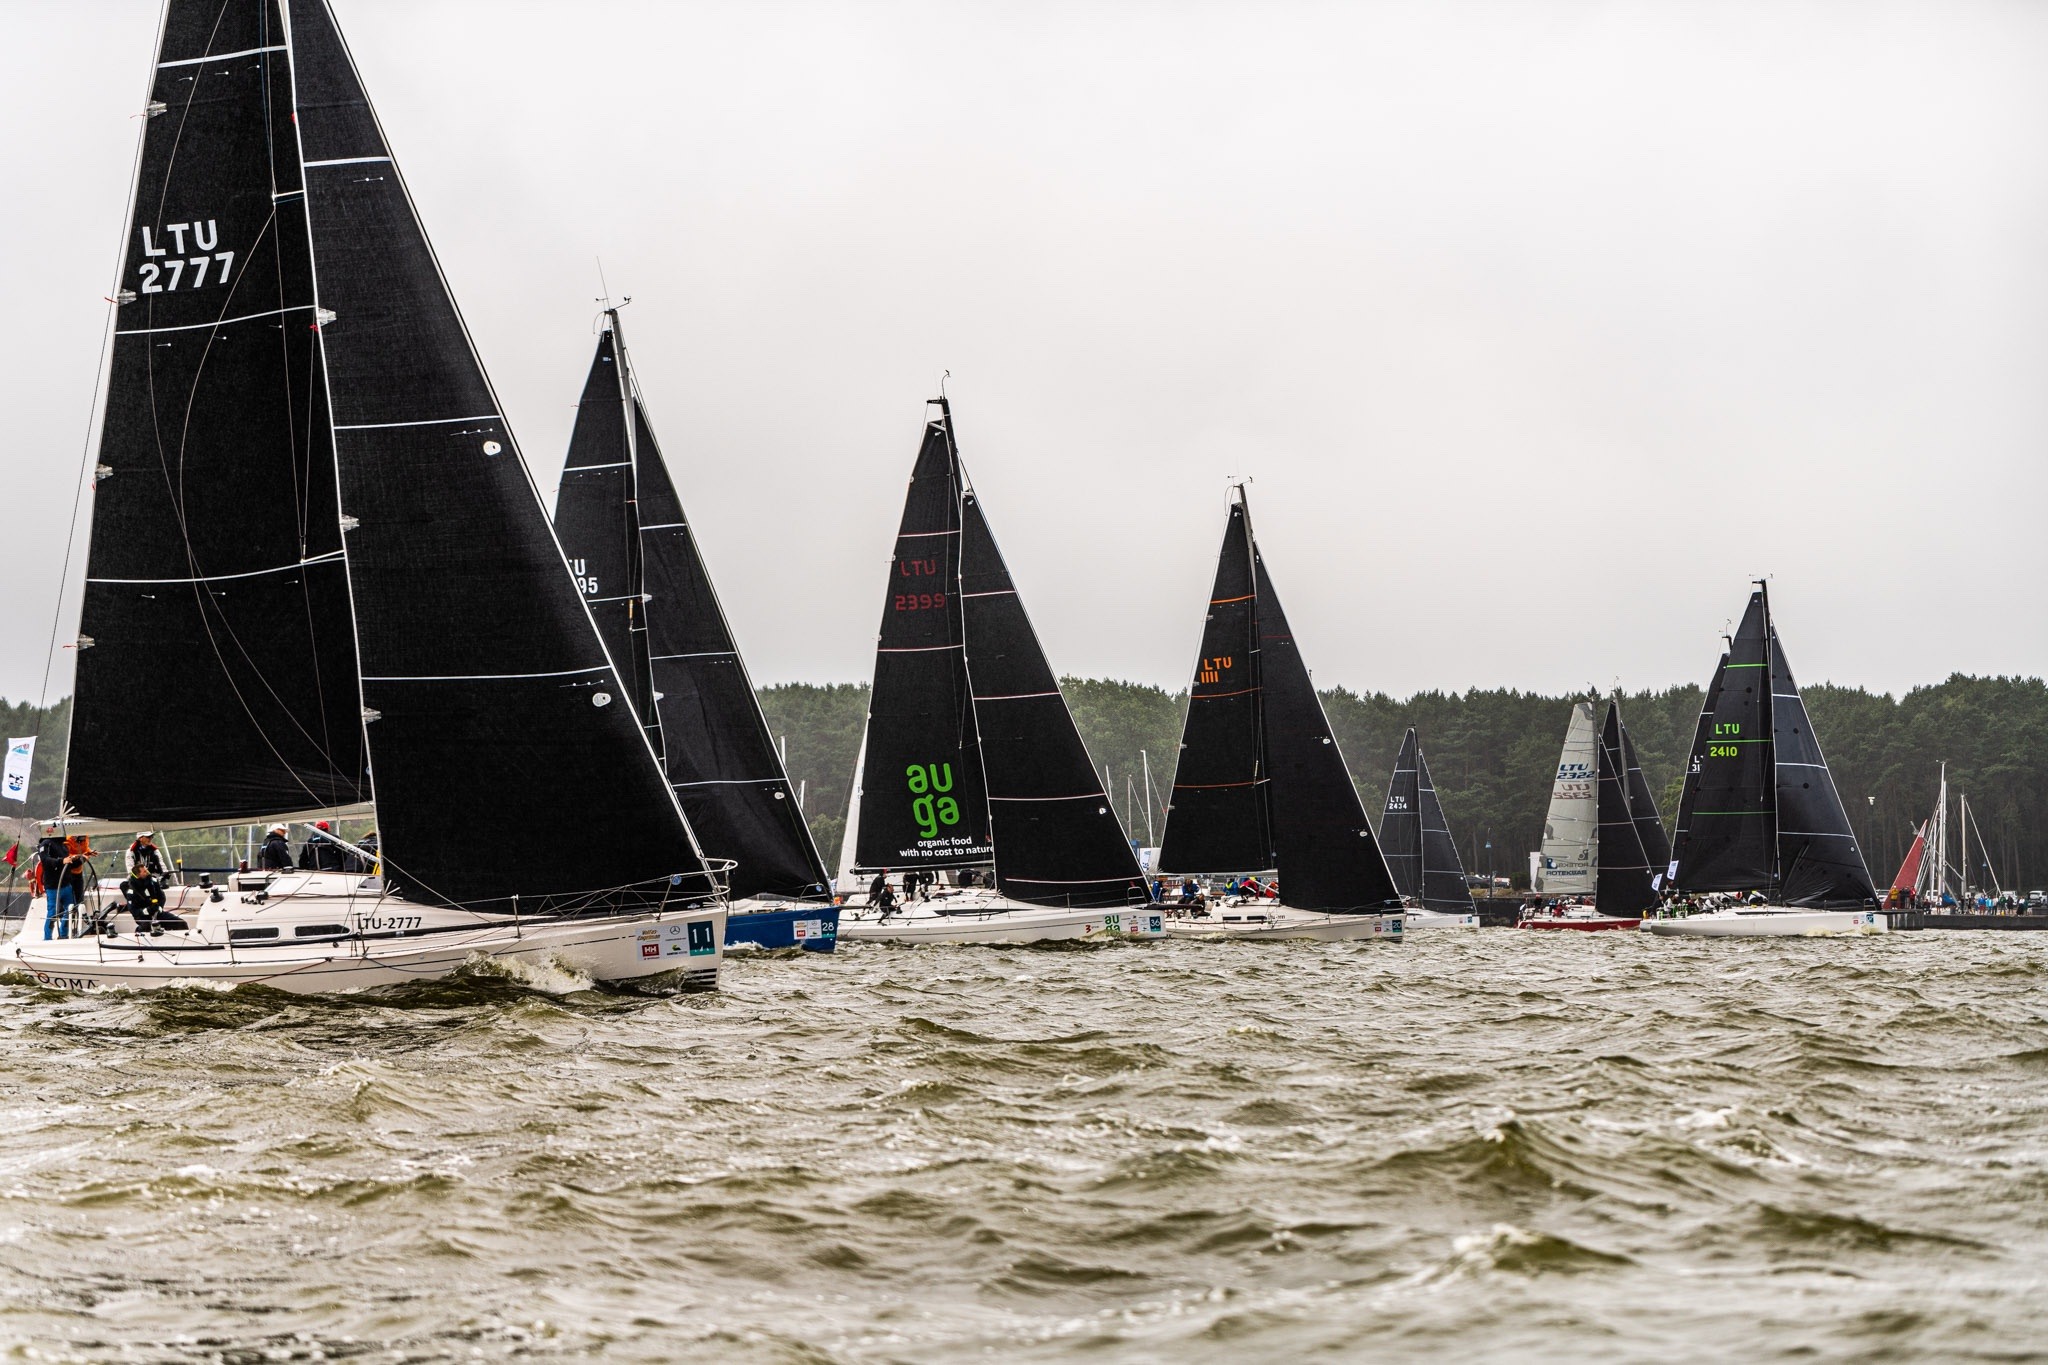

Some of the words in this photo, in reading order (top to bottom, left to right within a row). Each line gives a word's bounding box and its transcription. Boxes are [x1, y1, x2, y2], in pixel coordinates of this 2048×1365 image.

[142, 219, 218, 257] LTU
[139, 251, 235, 294] 2777
[568, 558, 586, 576] U
[900, 559, 936, 577] LTU
[895, 592, 946, 611] 2399
[1203, 656, 1233, 671] LTU
[1715, 723, 1740, 735] LTU
[1709, 746, 1738, 757] 2410
[1559, 763, 1589, 771] LTU
[906, 763, 954, 794] au
[1556, 771, 1595, 780] 2322
[1390, 795, 1405, 803] LTU
[1388, 802, 1408, 810] 2434
[912, 793, 960, 838] ga
[917, 837, 950, 849] organic
[951, 836, 973, 846] food
[899, 848, 920, 857] with
[921, 849, 933, 857] no
[934, 848, 953, 856] cost
[357, 916, 422, 930] LTU-2777
[1104, 914, 1120, 924] au
[1150, 918, 1161, 927] 36
[1392, 921, 1402, 929] 20
[821, 921, 835, 932] 28
[692, 927, 711, 944] 11
